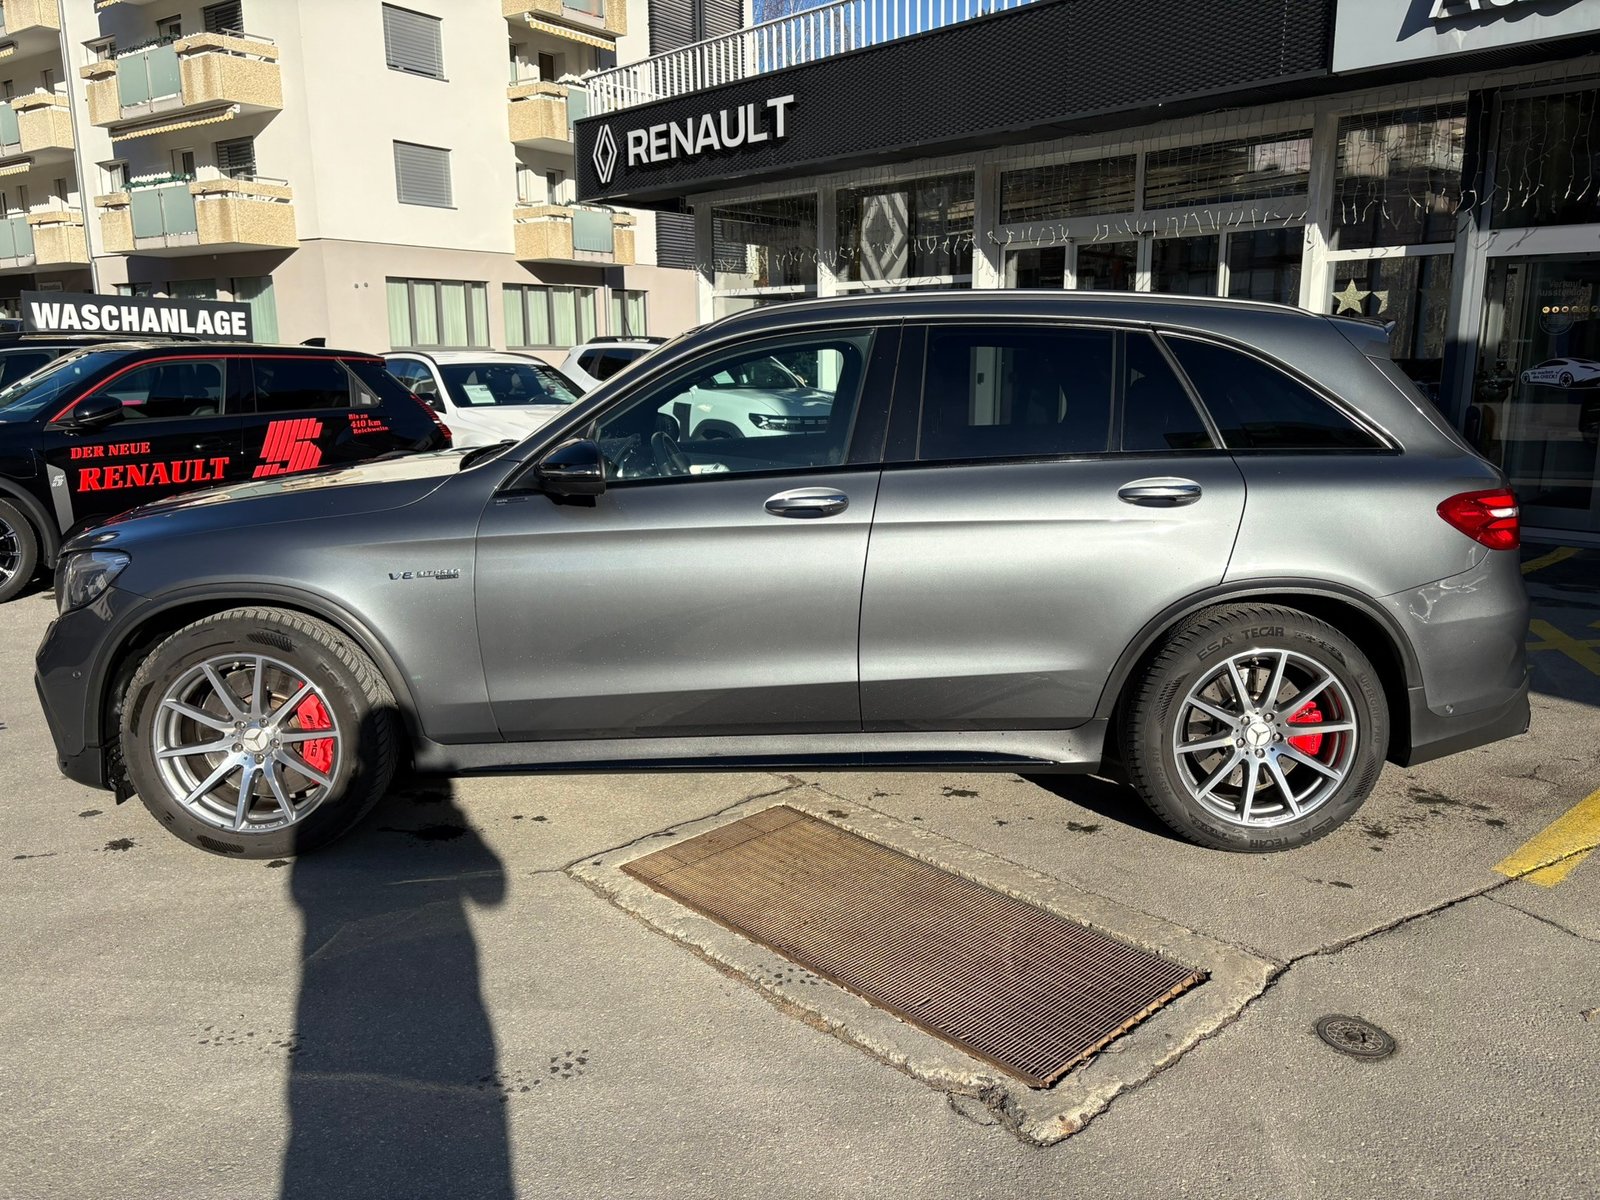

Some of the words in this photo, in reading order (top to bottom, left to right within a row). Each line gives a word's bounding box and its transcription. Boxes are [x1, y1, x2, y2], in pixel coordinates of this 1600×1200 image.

[627, 95, 794, 166] RENAULT
[31, 302, 247, 336] WASCHANLAGE
[350, 420, 366, 428] 410
[367, 419, 381, 427] km
[70, 445, 104, 460] DER
[108, 442, 151, 456] NEUE
[77, 457, 230, 492] RENAULT
[388, 572, 413, 580] V8
[1241, 627, 1284, 640] TECAR
